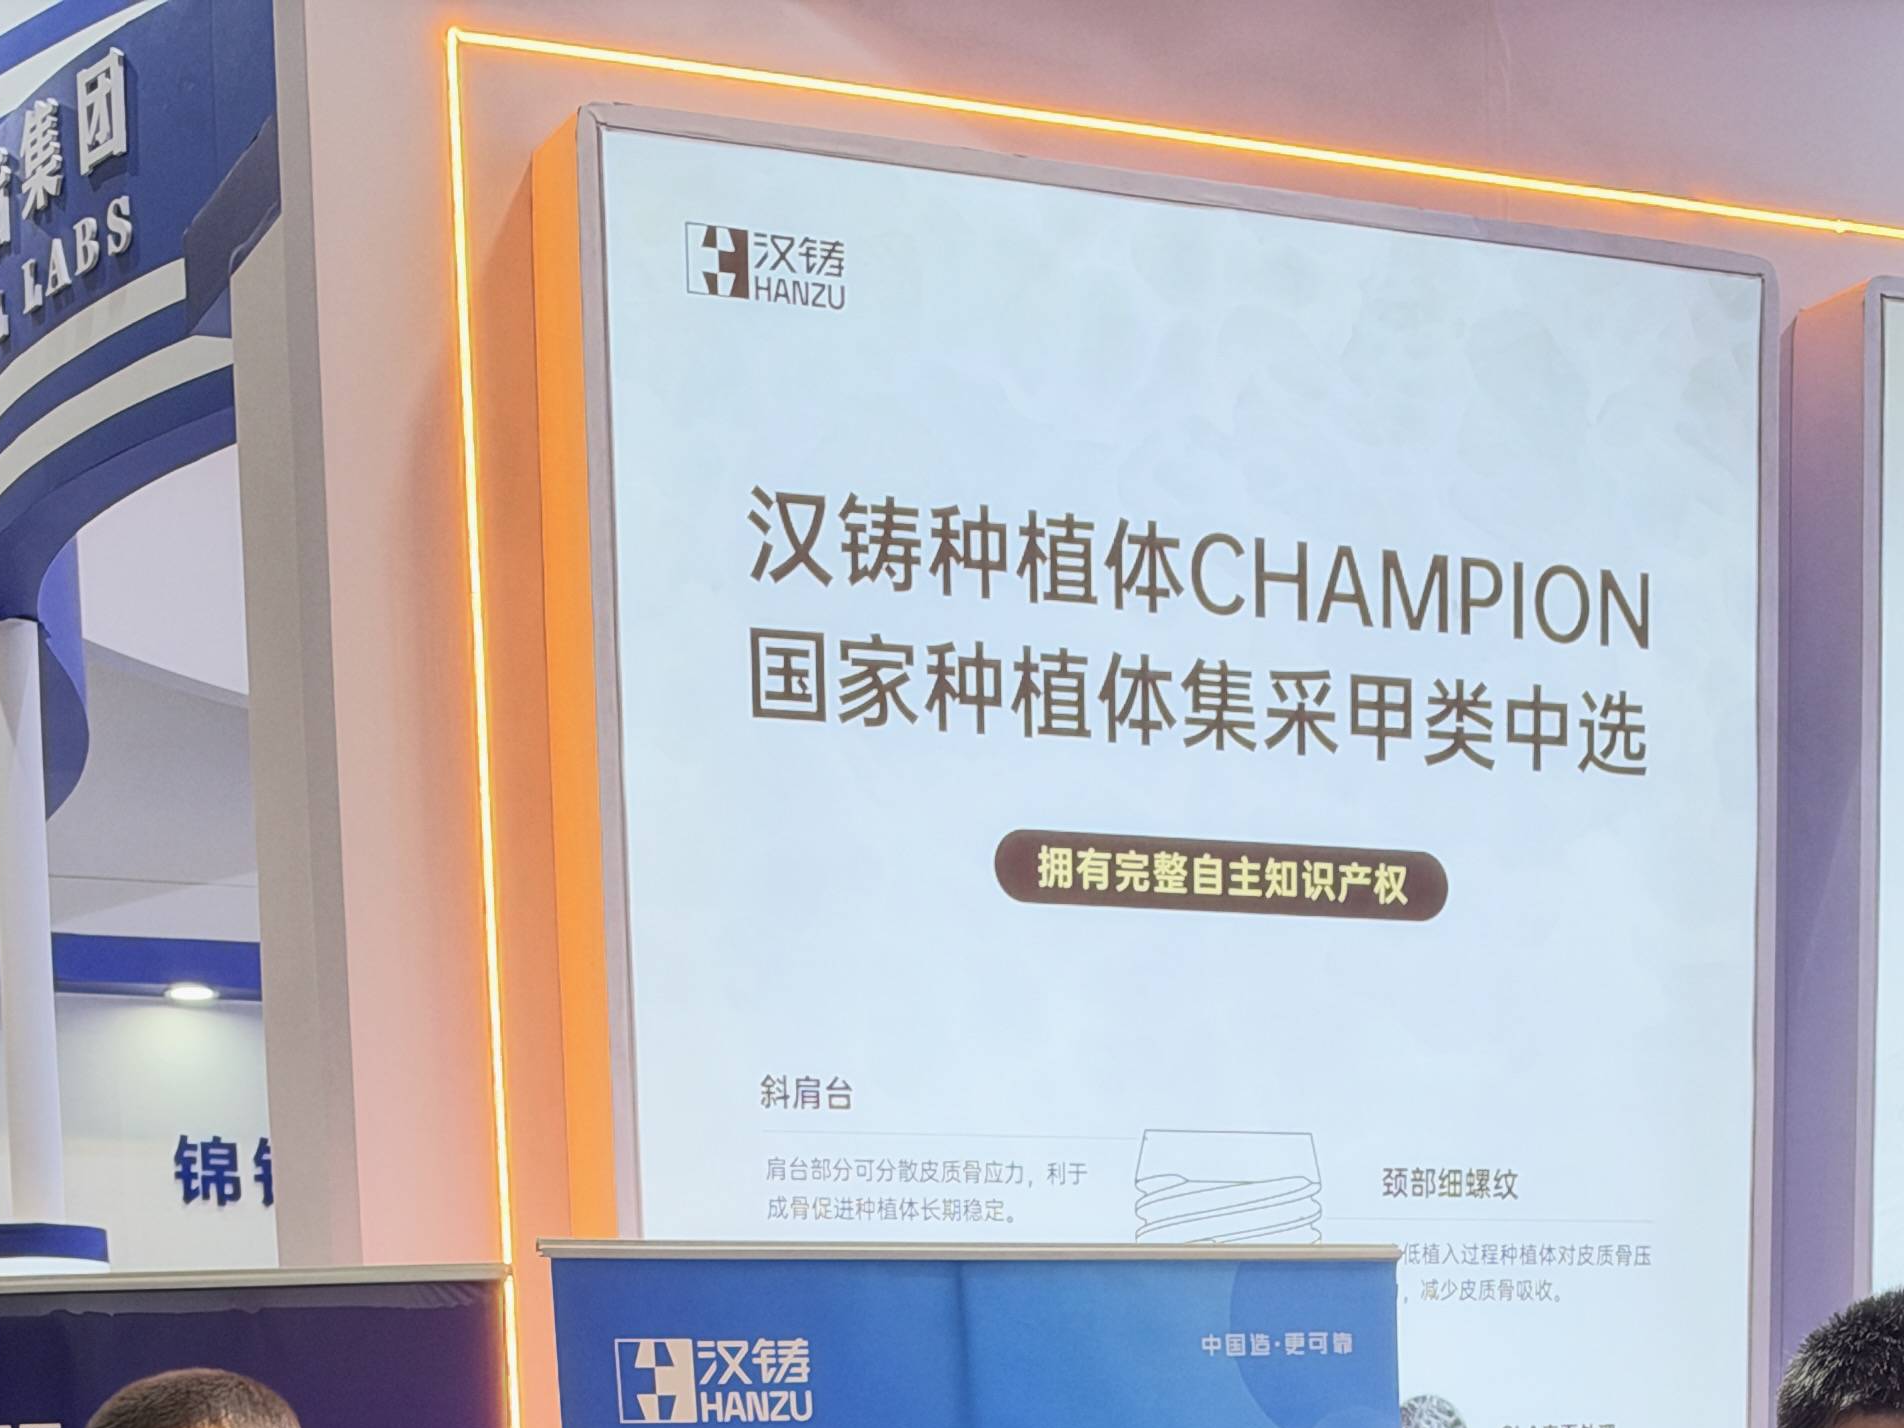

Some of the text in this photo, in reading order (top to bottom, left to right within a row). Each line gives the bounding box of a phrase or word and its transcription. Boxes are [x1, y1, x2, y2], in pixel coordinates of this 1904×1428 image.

[22, 195, 132, 316] LABS
[753, 231, 846, 279] 汉铸
[753, 275, 846, 312] HANZU
[746, 484, 1653, 651] 汉铸种植体CHAMPION
[749, 626, 1648, 777] 国家种植体集采甲类中选
[1036, 842, 1410, 906] 拥有完整自主知识产权
[760, 1074, 852, 1110] 斜肩台
[765, 1155, 1089, 1188] 肩台部分可分散皮质骨应力，利于
[1382, 1166, 1520, 1201] 颈部细螺纹
[766, 1196, 1016, 1225] 成骨促进种植体长期稳定。
[1396, 1279, 1562, 1304] ，减少皮质骨吸收。
[698, 1337, 810, 1387] 汉铸
[701, 1388, 813, 1424] HANZU
